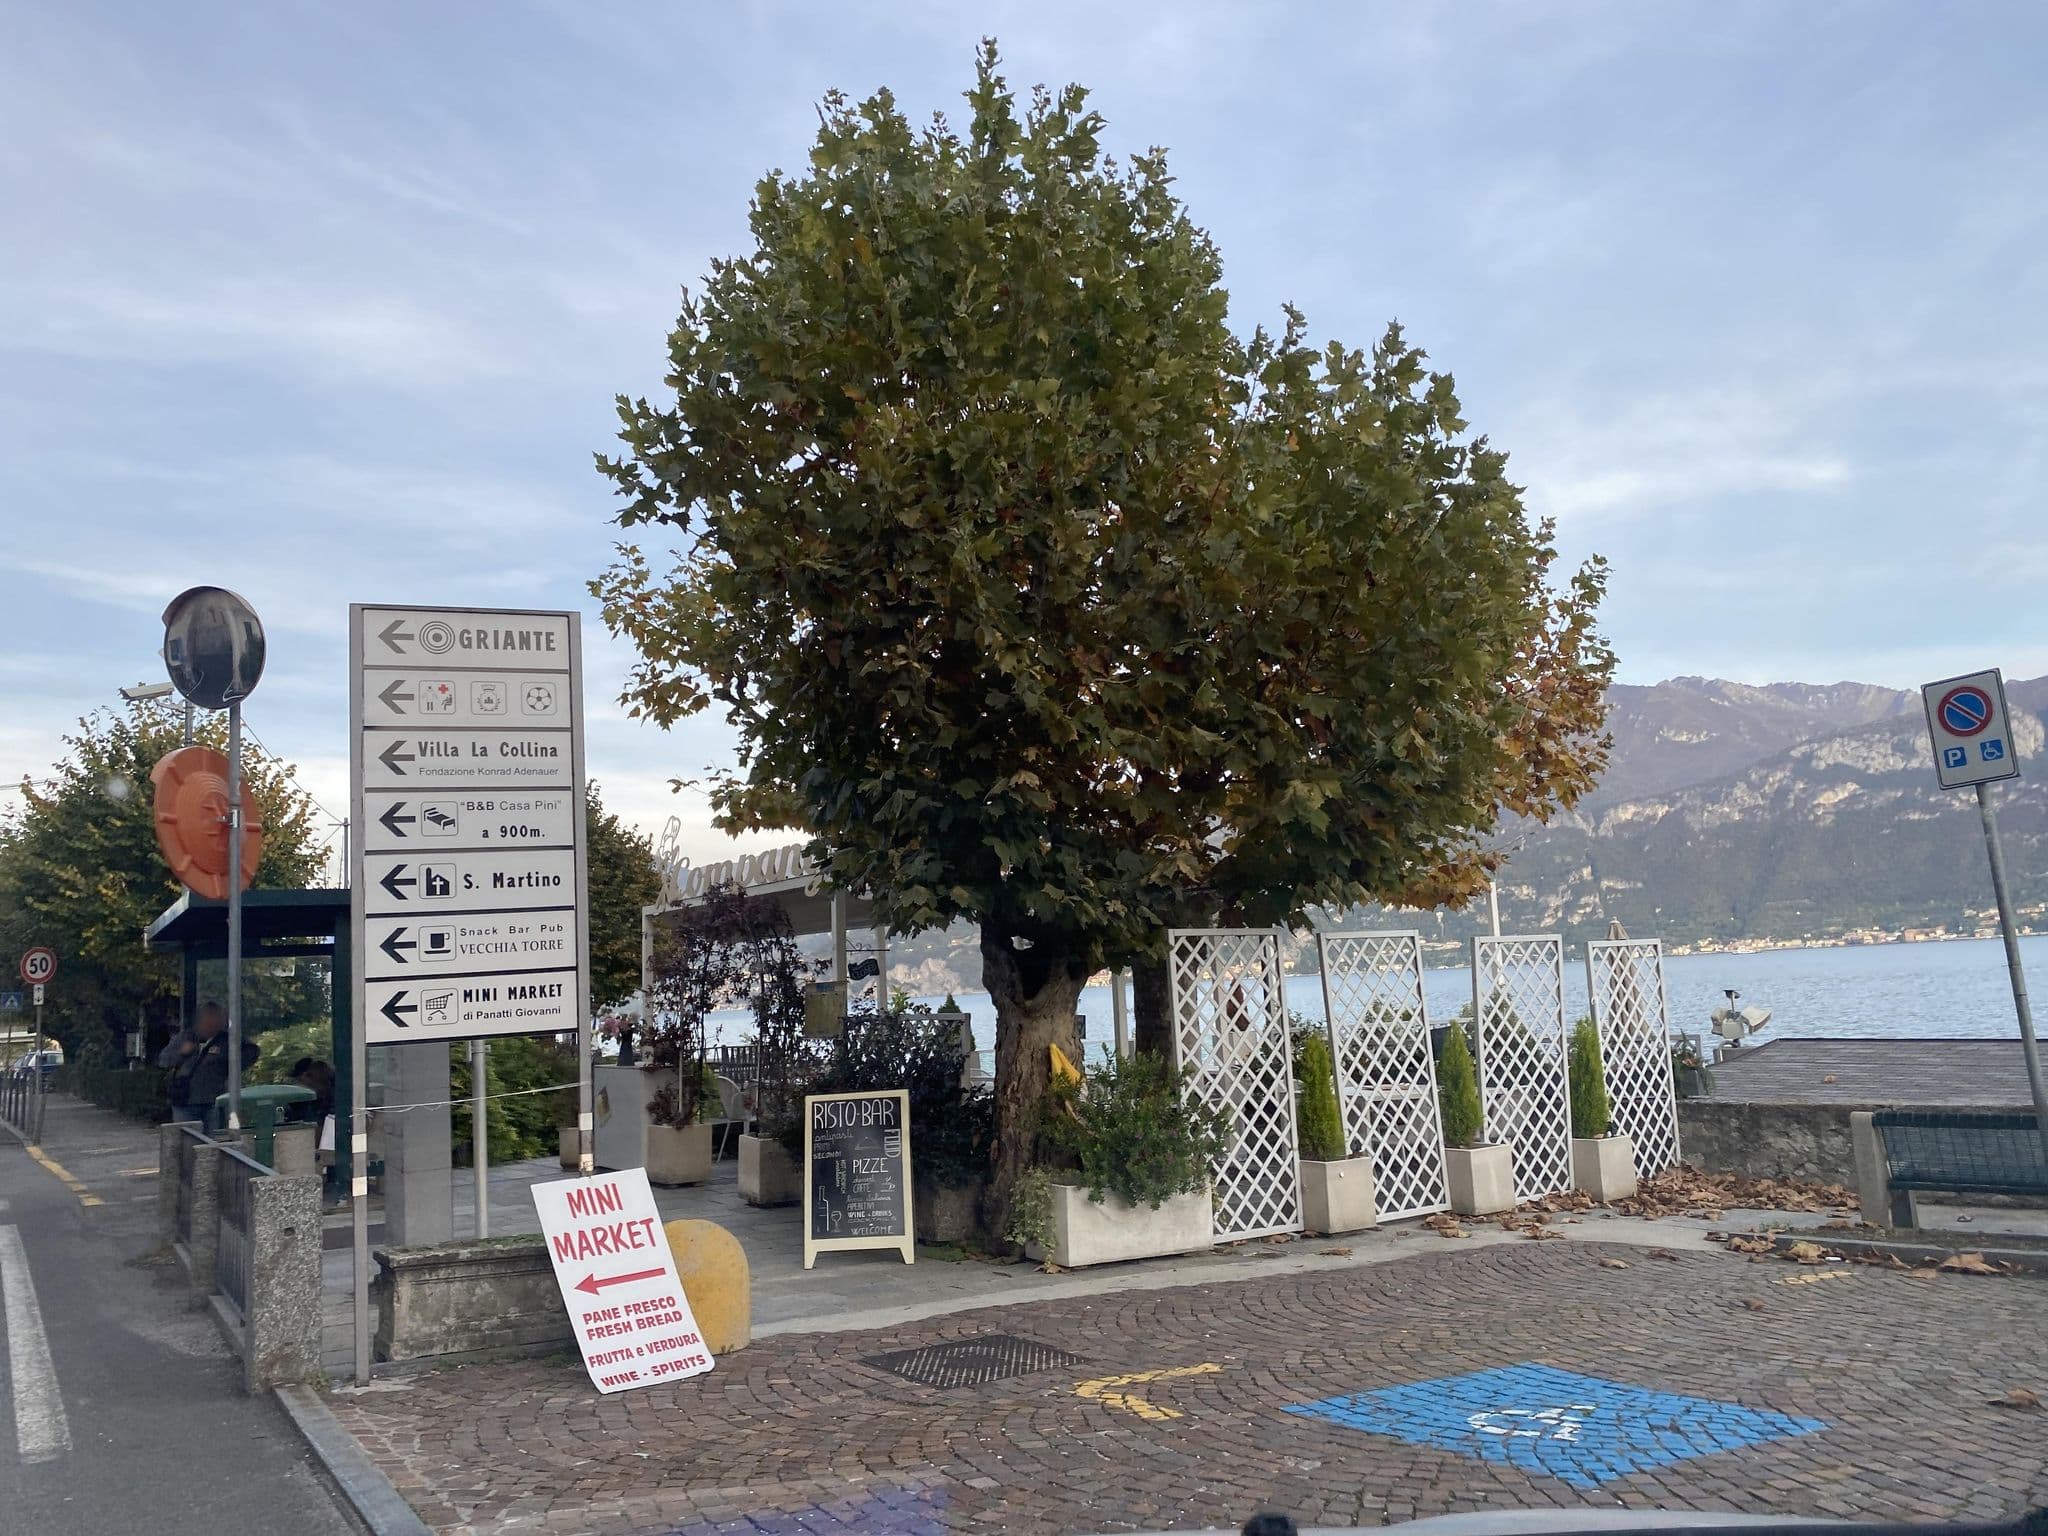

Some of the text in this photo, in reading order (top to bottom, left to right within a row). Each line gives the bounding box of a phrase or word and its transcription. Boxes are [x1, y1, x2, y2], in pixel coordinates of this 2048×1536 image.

[458, 628, 556, 651] GRIANTE
[418, 741, 558, 758] Villa La Collina
[419, 767, 559, 776] Fondazione Konrad Adenauer
[500, 801, 531, 811] Casa
[482, 825, 546, 839] a 900m.
[463, 871, 561, 890] S. Martino
[460, 923, 564, 937] Snack Bar Pub
[459, 939, 564, 955] VECCHIA TORRE
[29, 957, 49, 974] 50
[463, 983, 563, 1003] MINI MARKET
[463, 1006, 561, 1021] di Panatti Giovanni
[852, 1158, 889, 1174] PIZZE
[566, 1183, 624, 1219] MINI
[851, 1225, 893, 1236] WELCOME
[553, 1217, 657, 1264] MARKET
[582, 1296, 677, 1325] PANE FRESCO
[587, 1311, 683, 1341] FRESH BREAD
[588, 1332, 701, 1369] FRUTTA e VERDURA
[601, 1371, 641, 1387] WINE
[651, 1355, 707, 1377] SPIRITS
